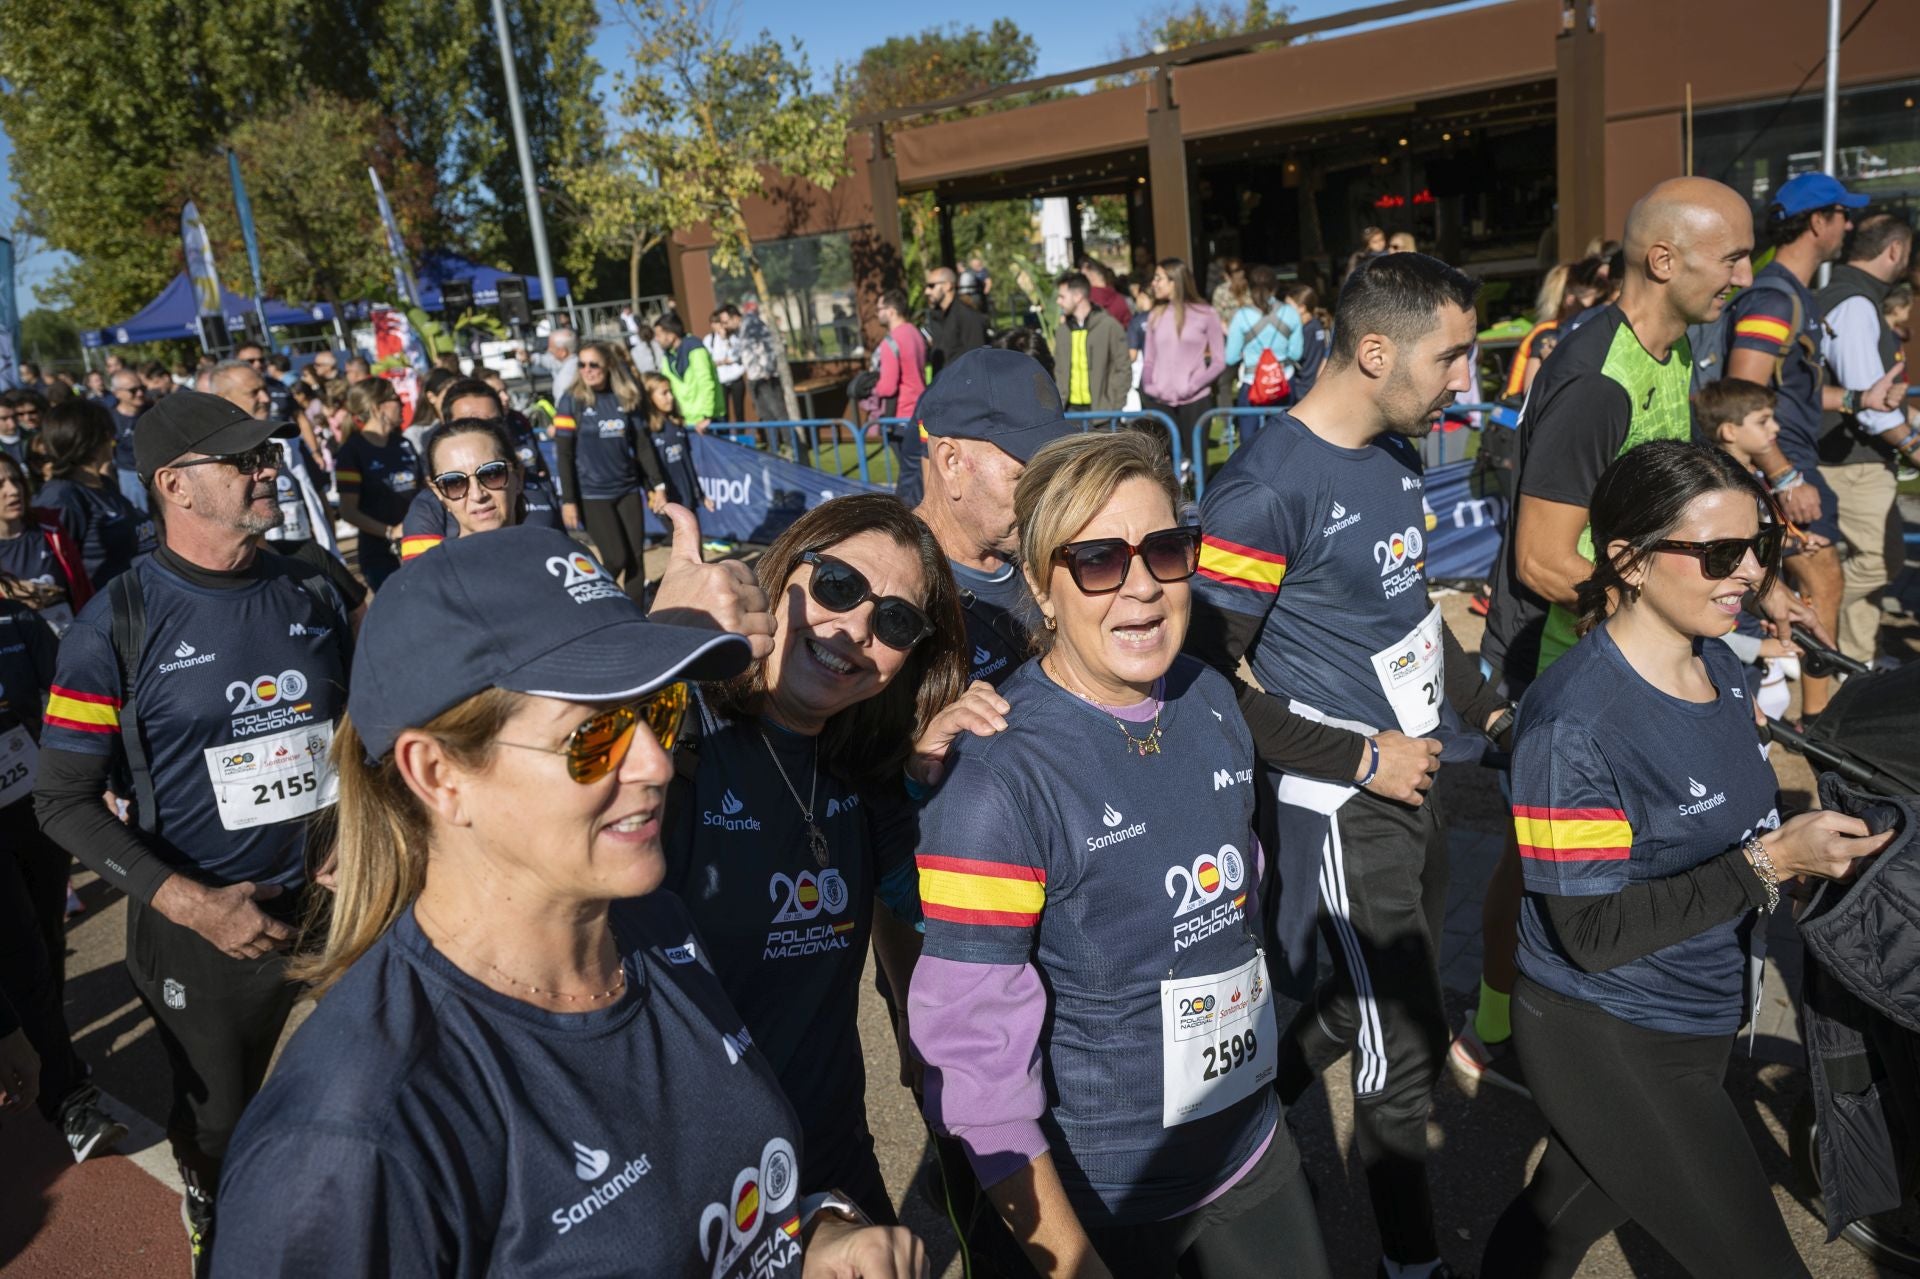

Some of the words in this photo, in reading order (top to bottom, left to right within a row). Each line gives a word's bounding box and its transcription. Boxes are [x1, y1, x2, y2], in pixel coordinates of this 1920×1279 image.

[1323, 513, 1361, 538] Santander
[1373, 526, 1423, 577] 200
[545, 552, 614, 588] 20
[159, 652, 217, 674] Santander
[225, 669, 308, 715] 200
[231, 705, 297, 729] POLICIA
[232, 711, 314, 738] NACIONAL
[251, 771, 317, 805] 2155
[1679, 792, 1727, 816] Santander
[1086, 822, 1147, 852] Santander
[769, 868, 849, 924] 200
[1164, 844, 1245, 919] 200
[766, 924, 836, 946] POLICIA
[1173, 900, 1237, 938] POLICIA
[1174, 908, 1245, 953] NACIONAL
[763, 935, 851, 961] NACIONAL
[1219, 1001, 1249, 1019] Santander
[1202, 1028, 1257, 1082] 2599
[551, 1153, 652, 1235] Santander
[699, 1137, 799, 1279] 200
